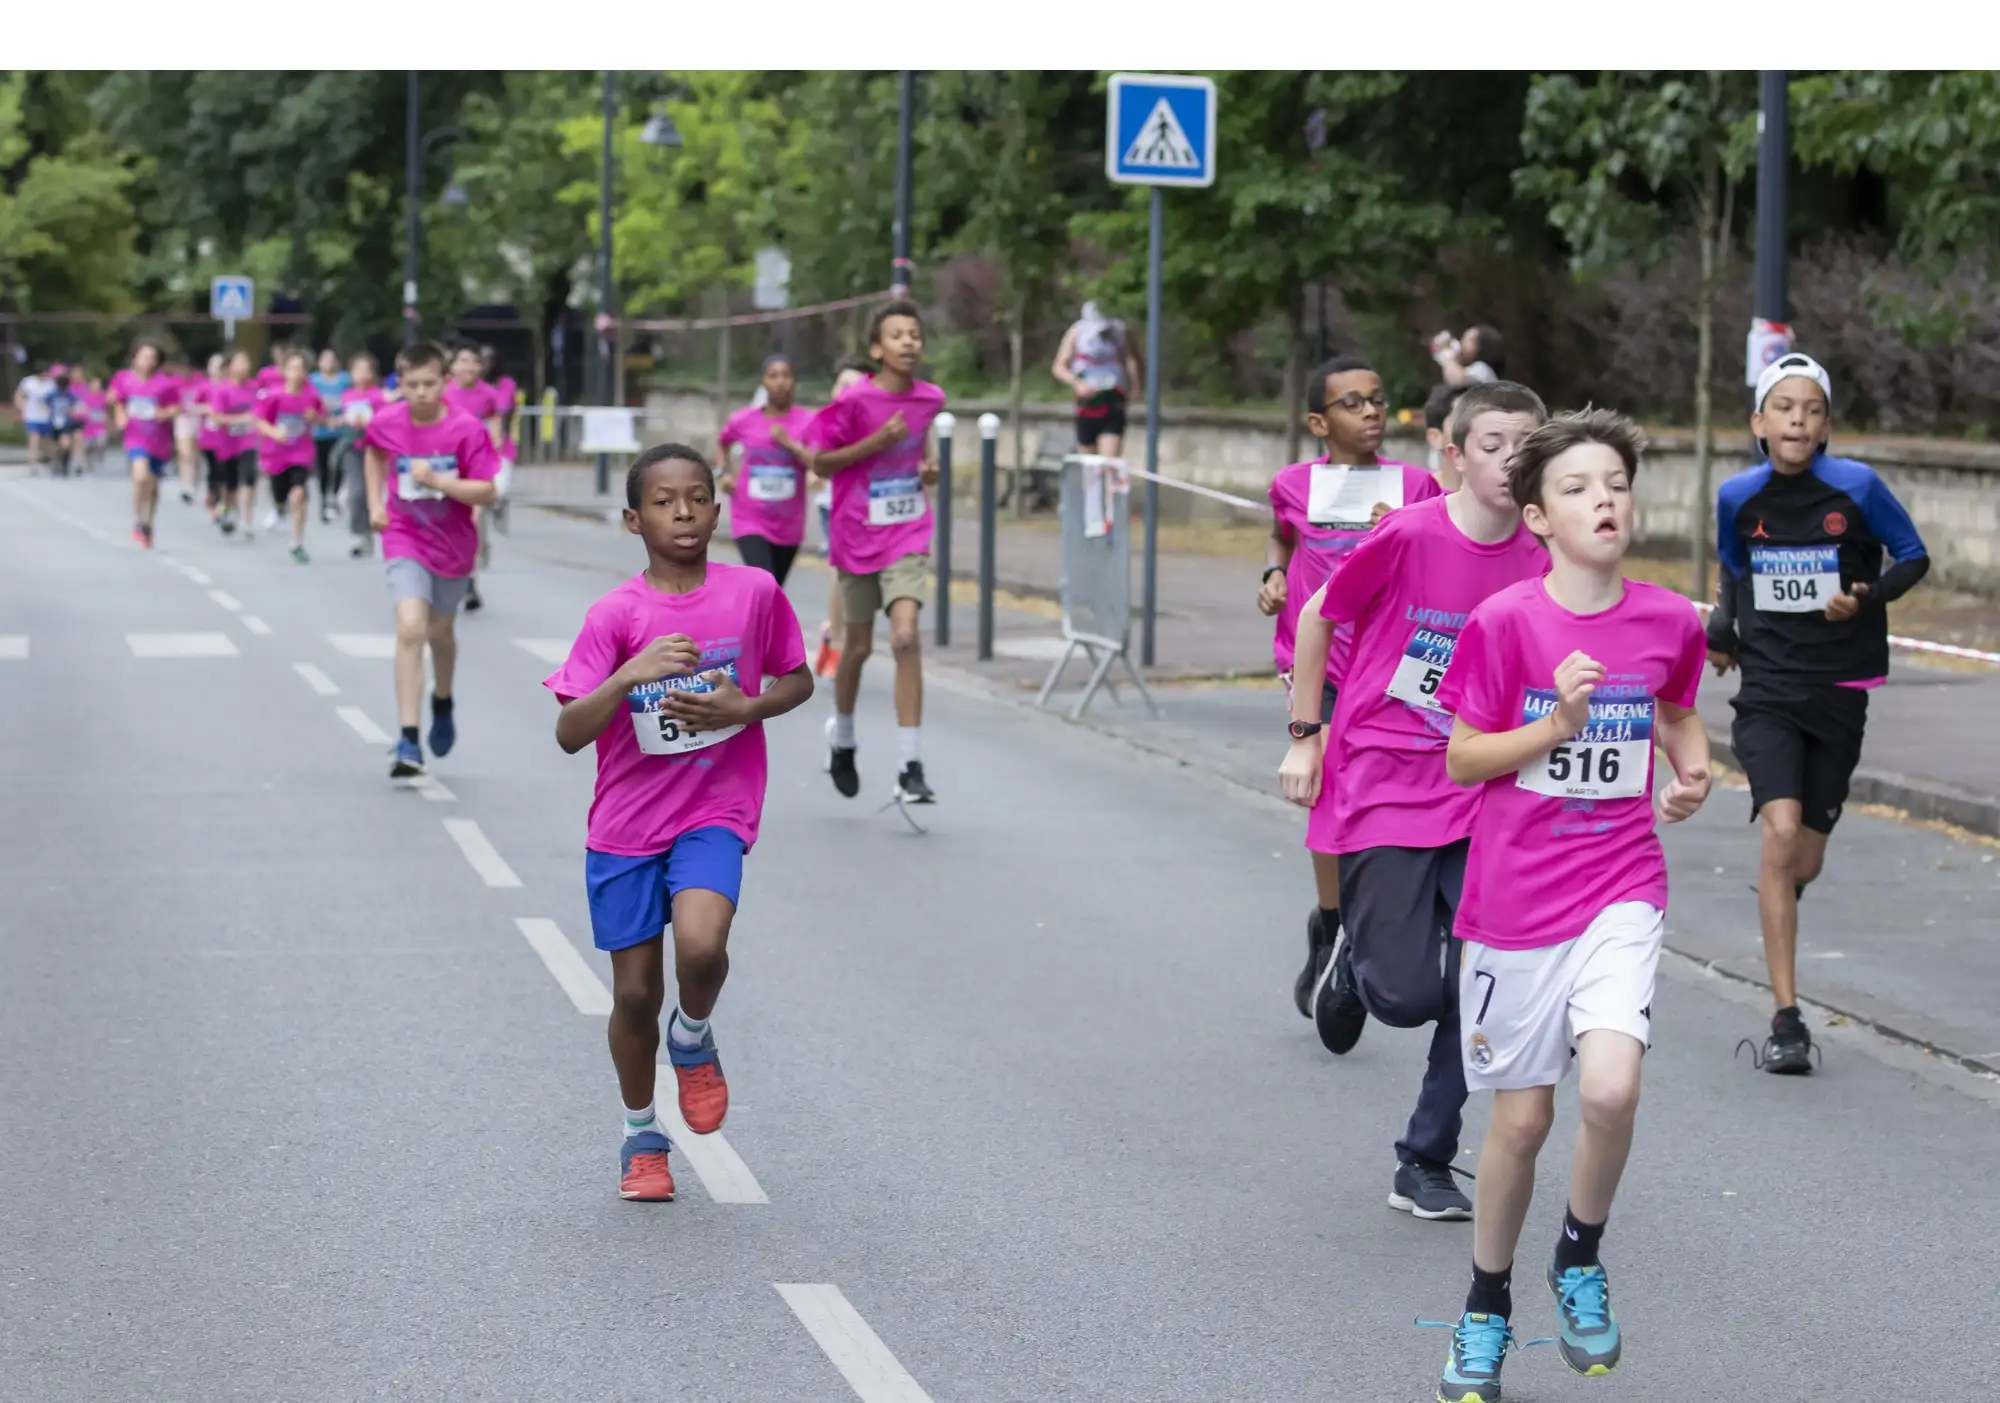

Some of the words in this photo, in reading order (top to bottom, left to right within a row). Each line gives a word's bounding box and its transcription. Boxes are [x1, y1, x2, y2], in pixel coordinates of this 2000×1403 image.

[1772, 579, 1818, 602] 504
[684, 740, 704, 749] EVAN
[1547, 747, 1620, 783] 516
[1566, 788, 1599, 796] MARTIN
[1475, 970, 1496, 1025] 7
